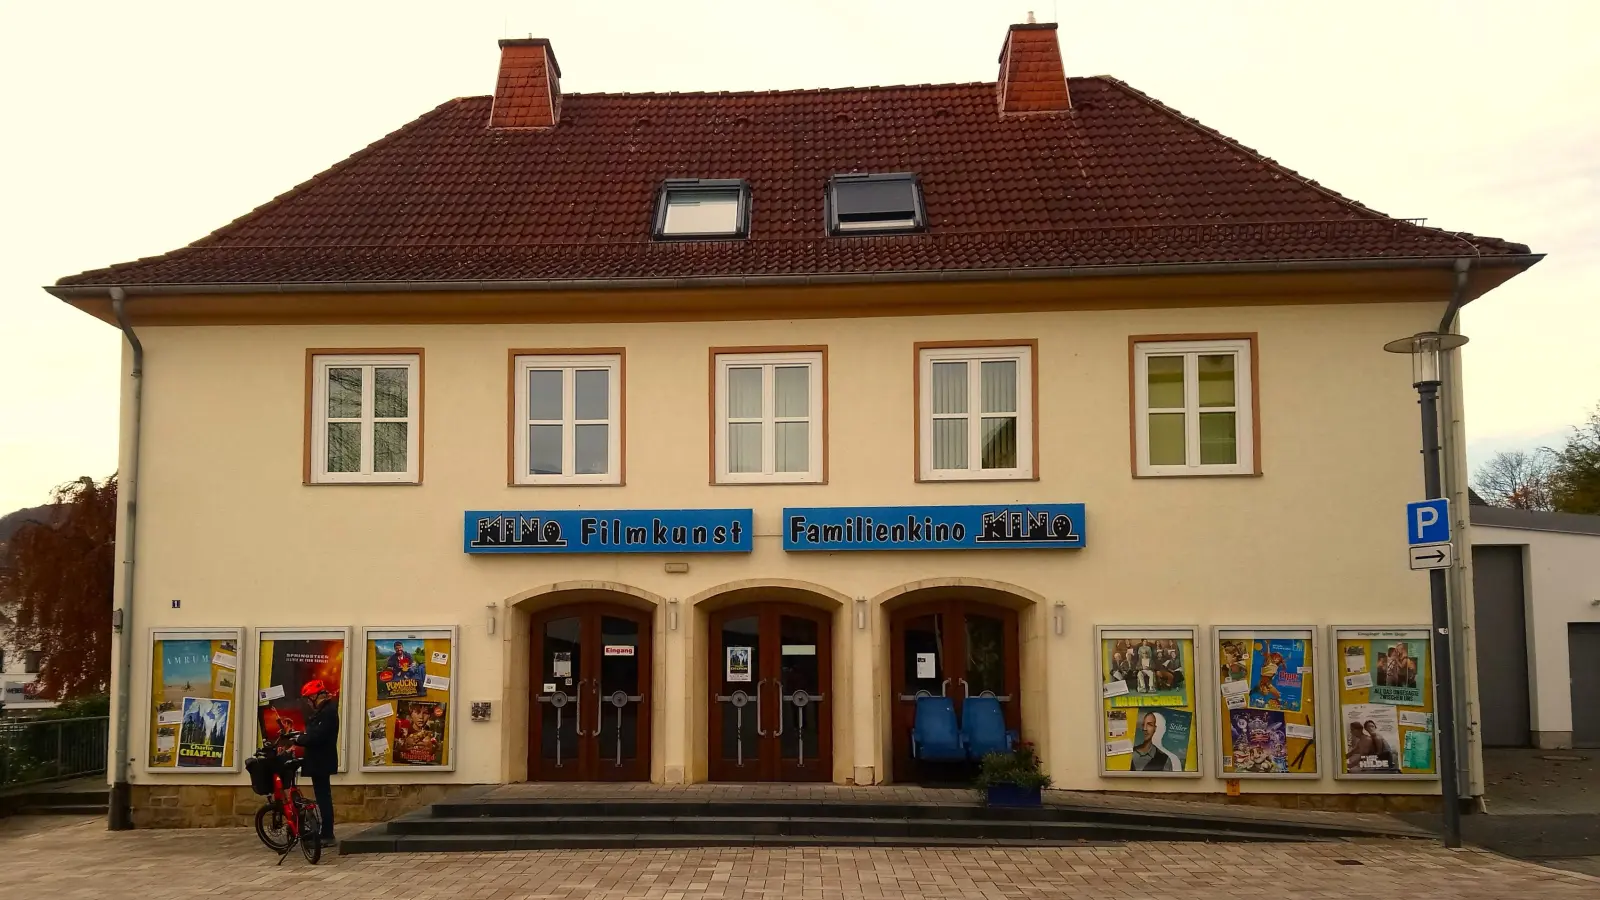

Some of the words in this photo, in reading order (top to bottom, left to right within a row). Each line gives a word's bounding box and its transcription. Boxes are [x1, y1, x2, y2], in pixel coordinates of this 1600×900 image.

[790, 515, 967, 543] Familienkino
[976, 508, 1079, 543] KINO
[1416, 506, 1439, 539] P
[472, 512, 567, 547] KINO
[580, 517, 744, 545] Filmkunst
[605, 647, 633, 655] Eingang
[166, 654, 209, 665] AMRUM
[386, 679, 418, 692] PUMUCKL
[1169, 723, 1187, 732] Stiller
[180, 748, 222, 759] CHAPLIN
[1359, 760, 1389, 768] HILDE
